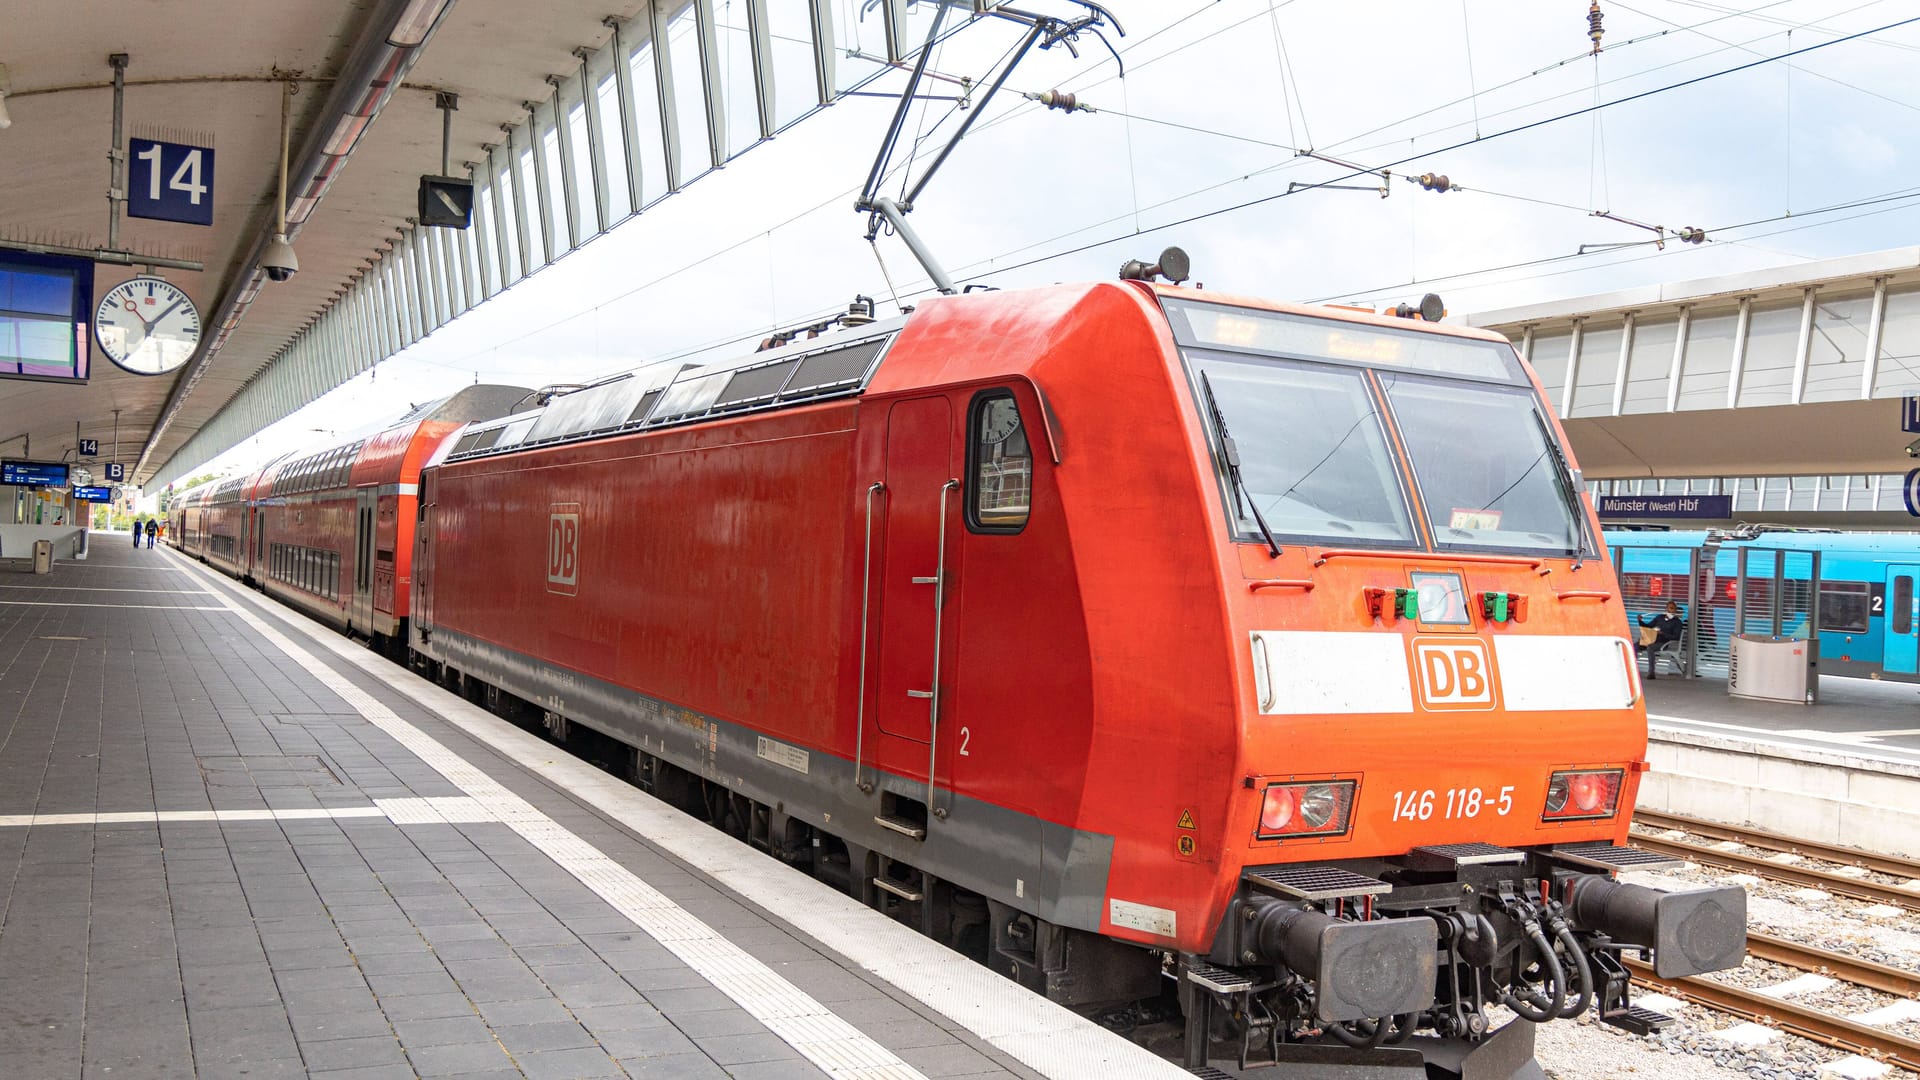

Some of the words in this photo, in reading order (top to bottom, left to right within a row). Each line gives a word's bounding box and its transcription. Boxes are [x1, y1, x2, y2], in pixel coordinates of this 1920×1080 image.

[138, 144, 207, 205] 14
[81, 440, 97, 453] 14
[111, 464, 122, 477] B
[1604, 499, 1647, 511] Münster
[1649, 502, 1676, 512] (Westf)
[1678, 499, 1700, 511] Hbf
[549, 518, 576, 579] DB
[1872, 596, 1883, 611] 2
[1424, 650, 1485, 697] DB
[1730, 654, 1738, 688] Abfall
[959, 726, 970, 756] 2
[1392, 789, 1435, 822] 146
[1445, 785, 1515, 819] 118-5
